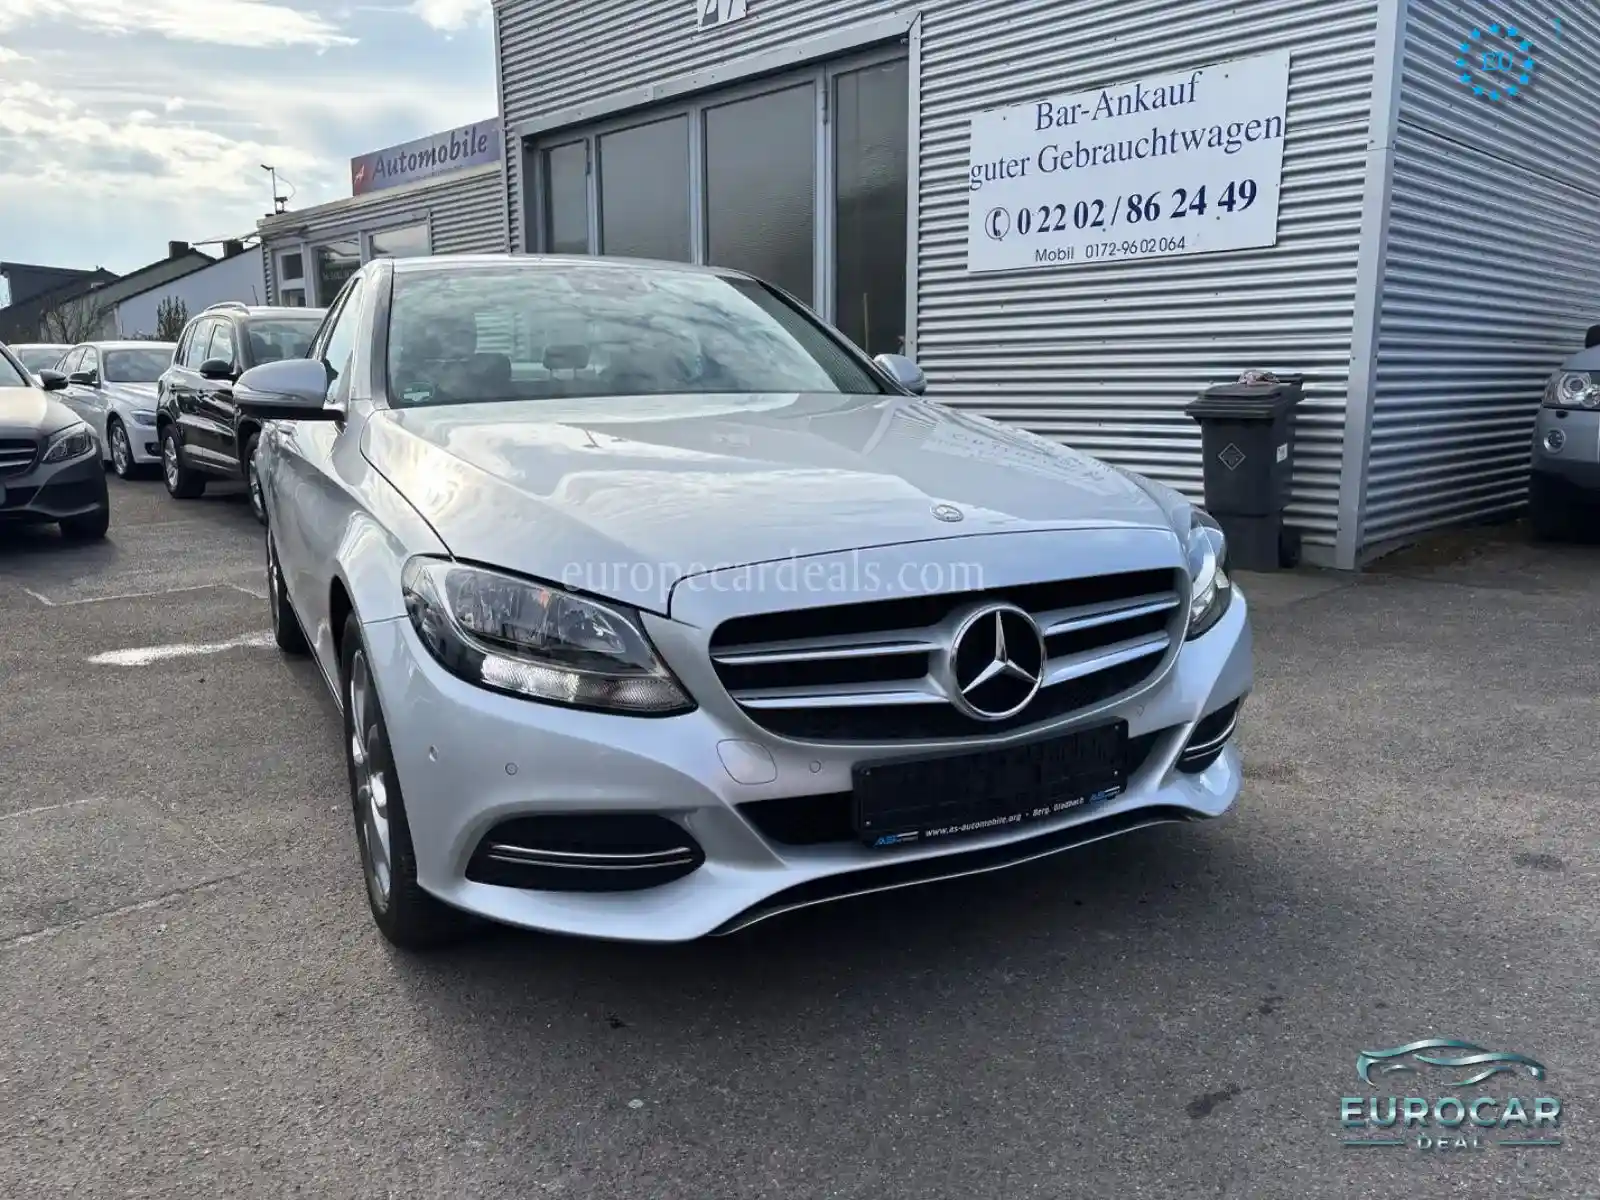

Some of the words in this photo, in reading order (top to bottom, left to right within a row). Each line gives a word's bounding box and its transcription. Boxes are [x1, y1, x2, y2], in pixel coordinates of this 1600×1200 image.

[1035, 71, 1203, 131] Bar-Ankauf
[372, 126, 488, 180] Automobile
[970, 155, 1031, 191] guter
[1037, 114, 1283, 174] Gebrauchtwagen
[1035, 246, 1075, 263] Mobil
